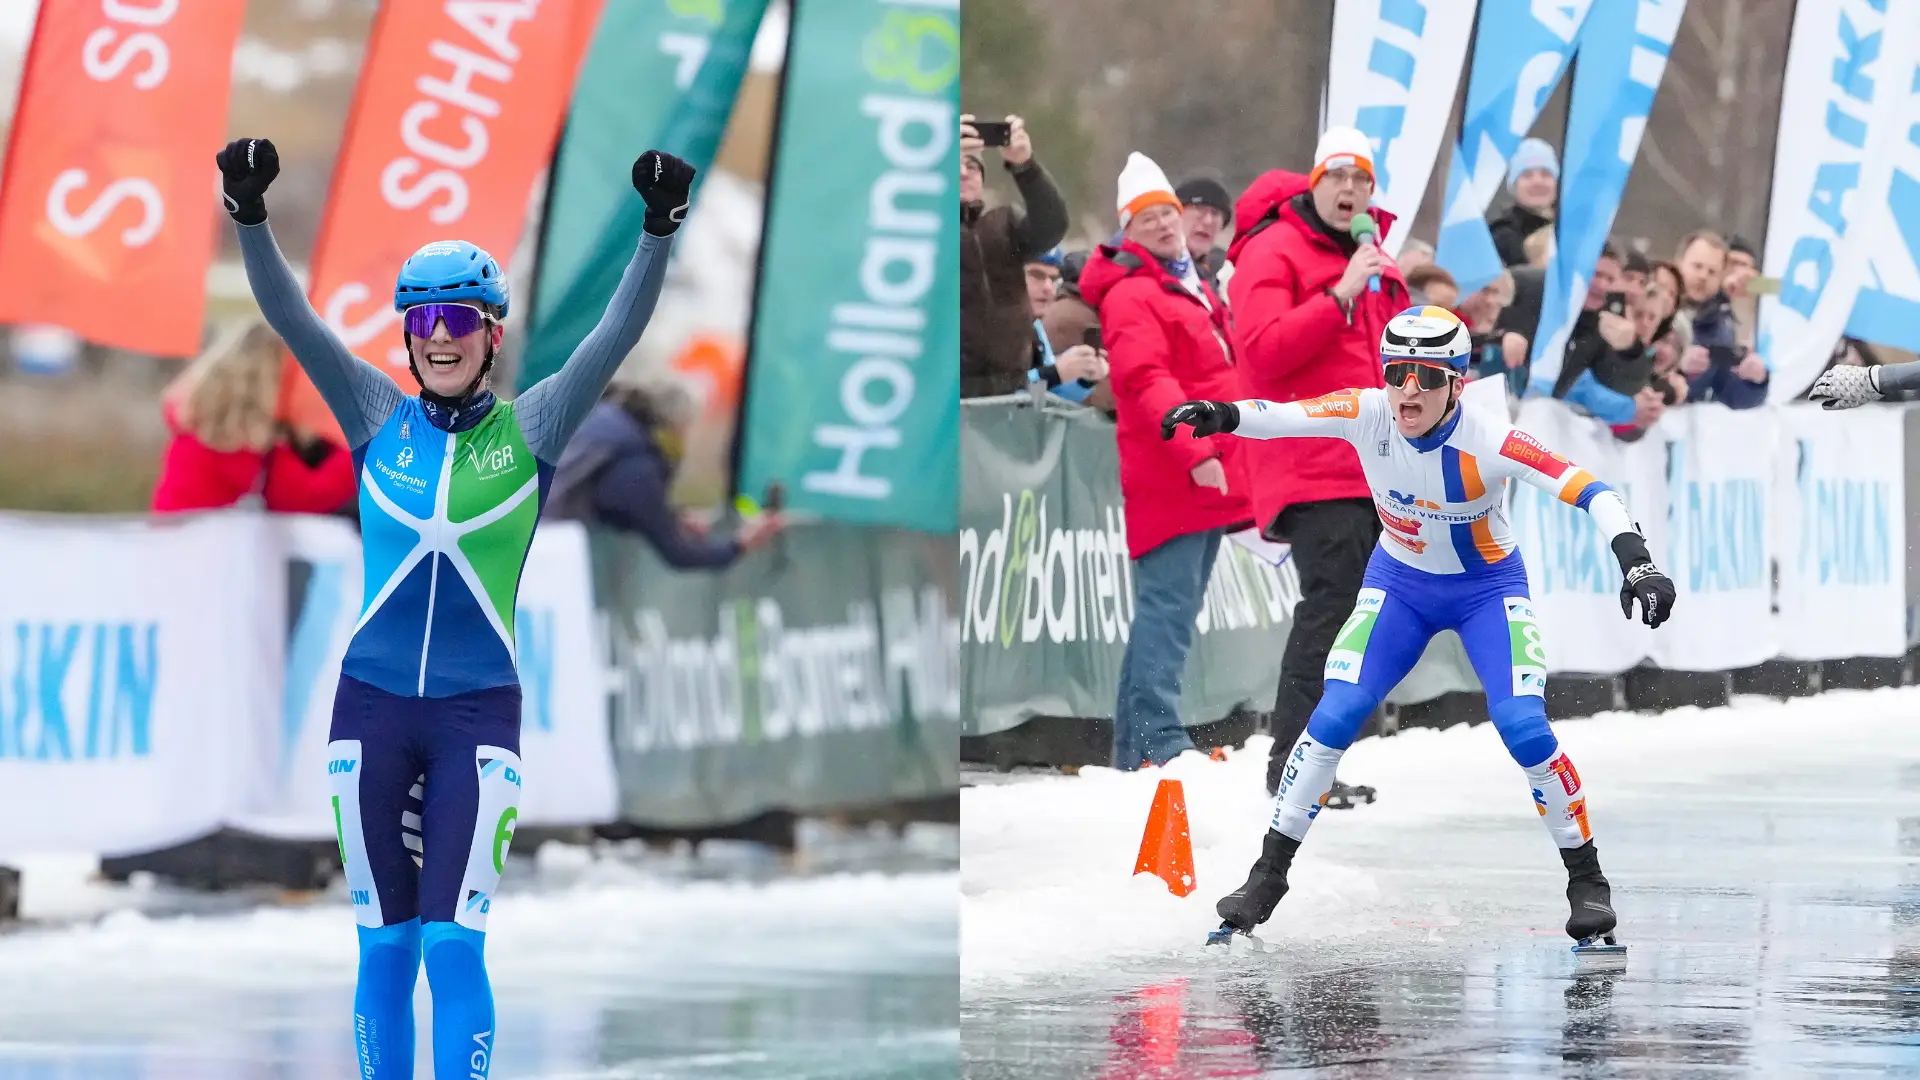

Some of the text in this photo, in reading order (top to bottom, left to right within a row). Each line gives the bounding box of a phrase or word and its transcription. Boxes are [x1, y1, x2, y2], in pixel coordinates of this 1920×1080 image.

[1779, 0, 1888, 321] DAIK
[1506, 441, 1545, 465] select
[375, 458, 427, 489] Vreugdenhil
[1384, 498, 1417, 515] HAAN
